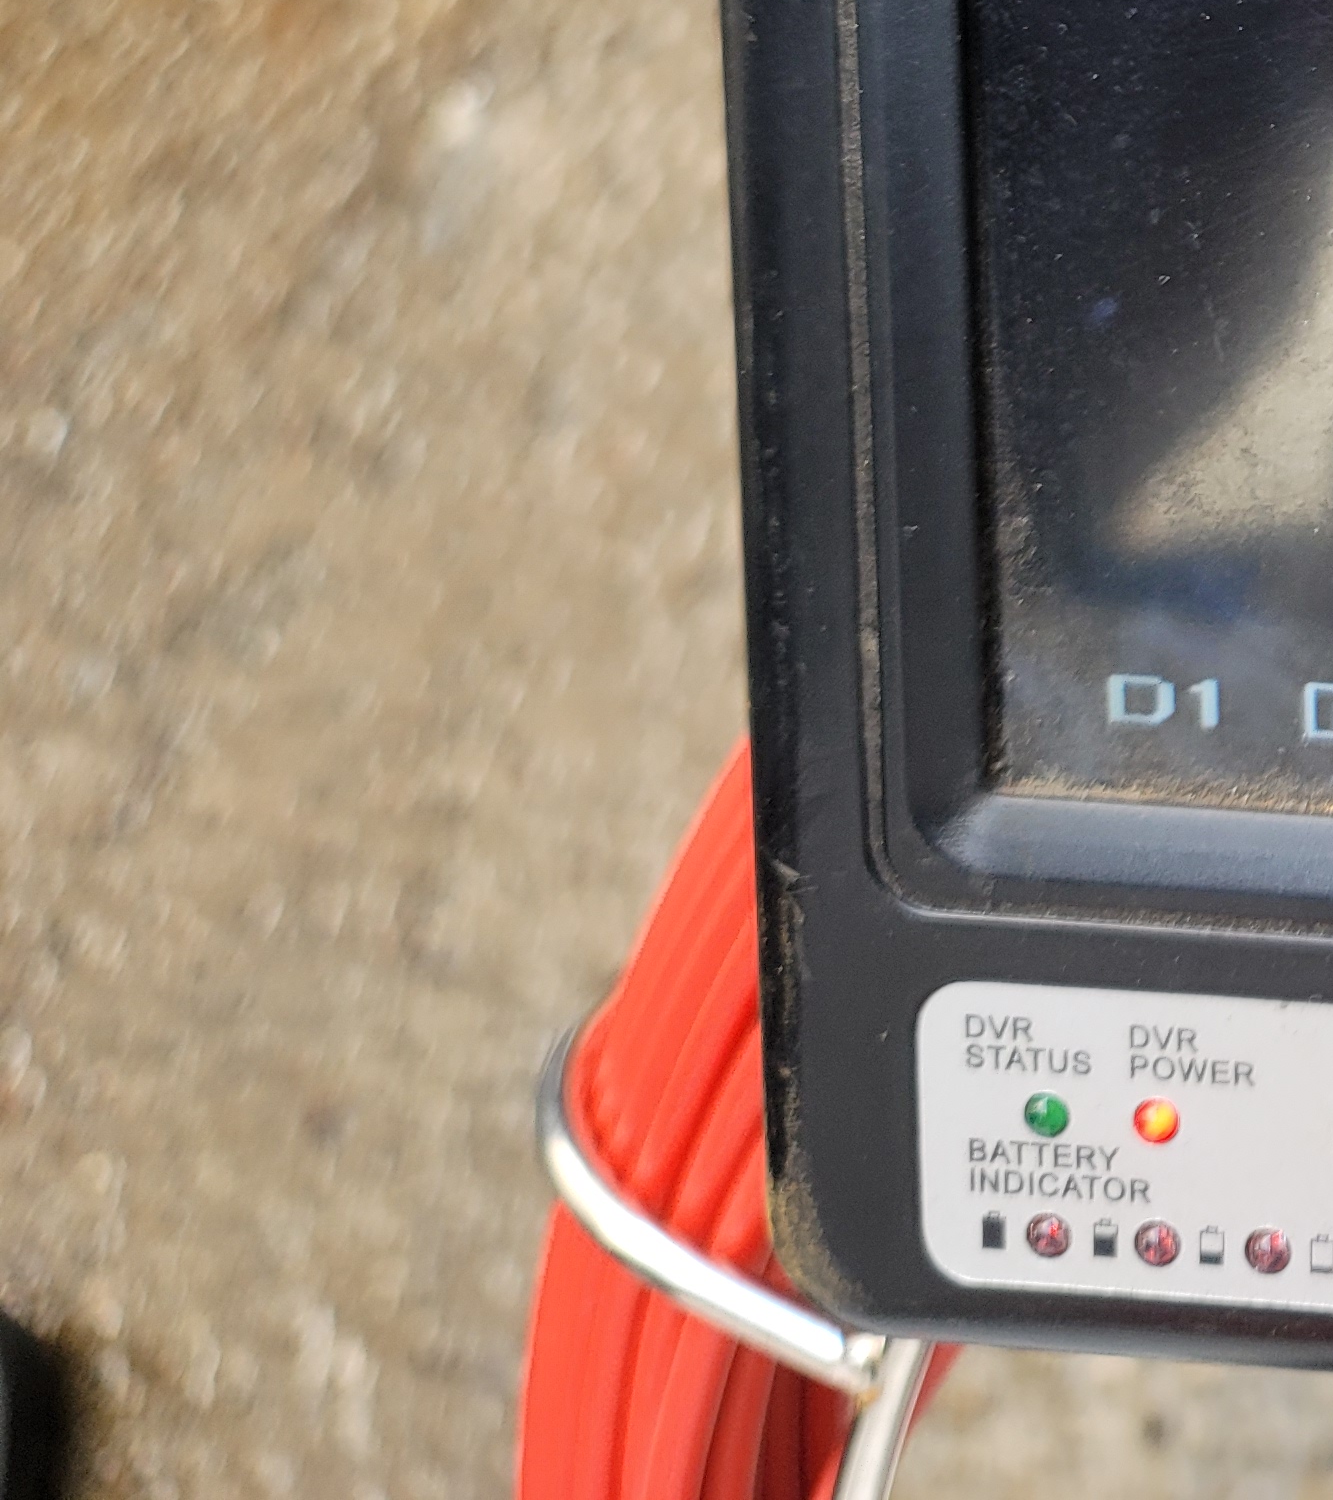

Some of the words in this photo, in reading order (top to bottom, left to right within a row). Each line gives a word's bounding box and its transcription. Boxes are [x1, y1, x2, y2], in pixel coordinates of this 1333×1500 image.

[1106, 672, 1220, 732] D1
[964, 1013, 1034, 1042] DVR
[1129, 1024, 1199, 1053] DVR
[965, 1044, 1092, 1076] STATUS
[1129, 1055, 1257, 1087] POWER
[968, 1138, 1121, 1171] BATTERY
[968, 1167, 1152, 1204] INDICATOR
